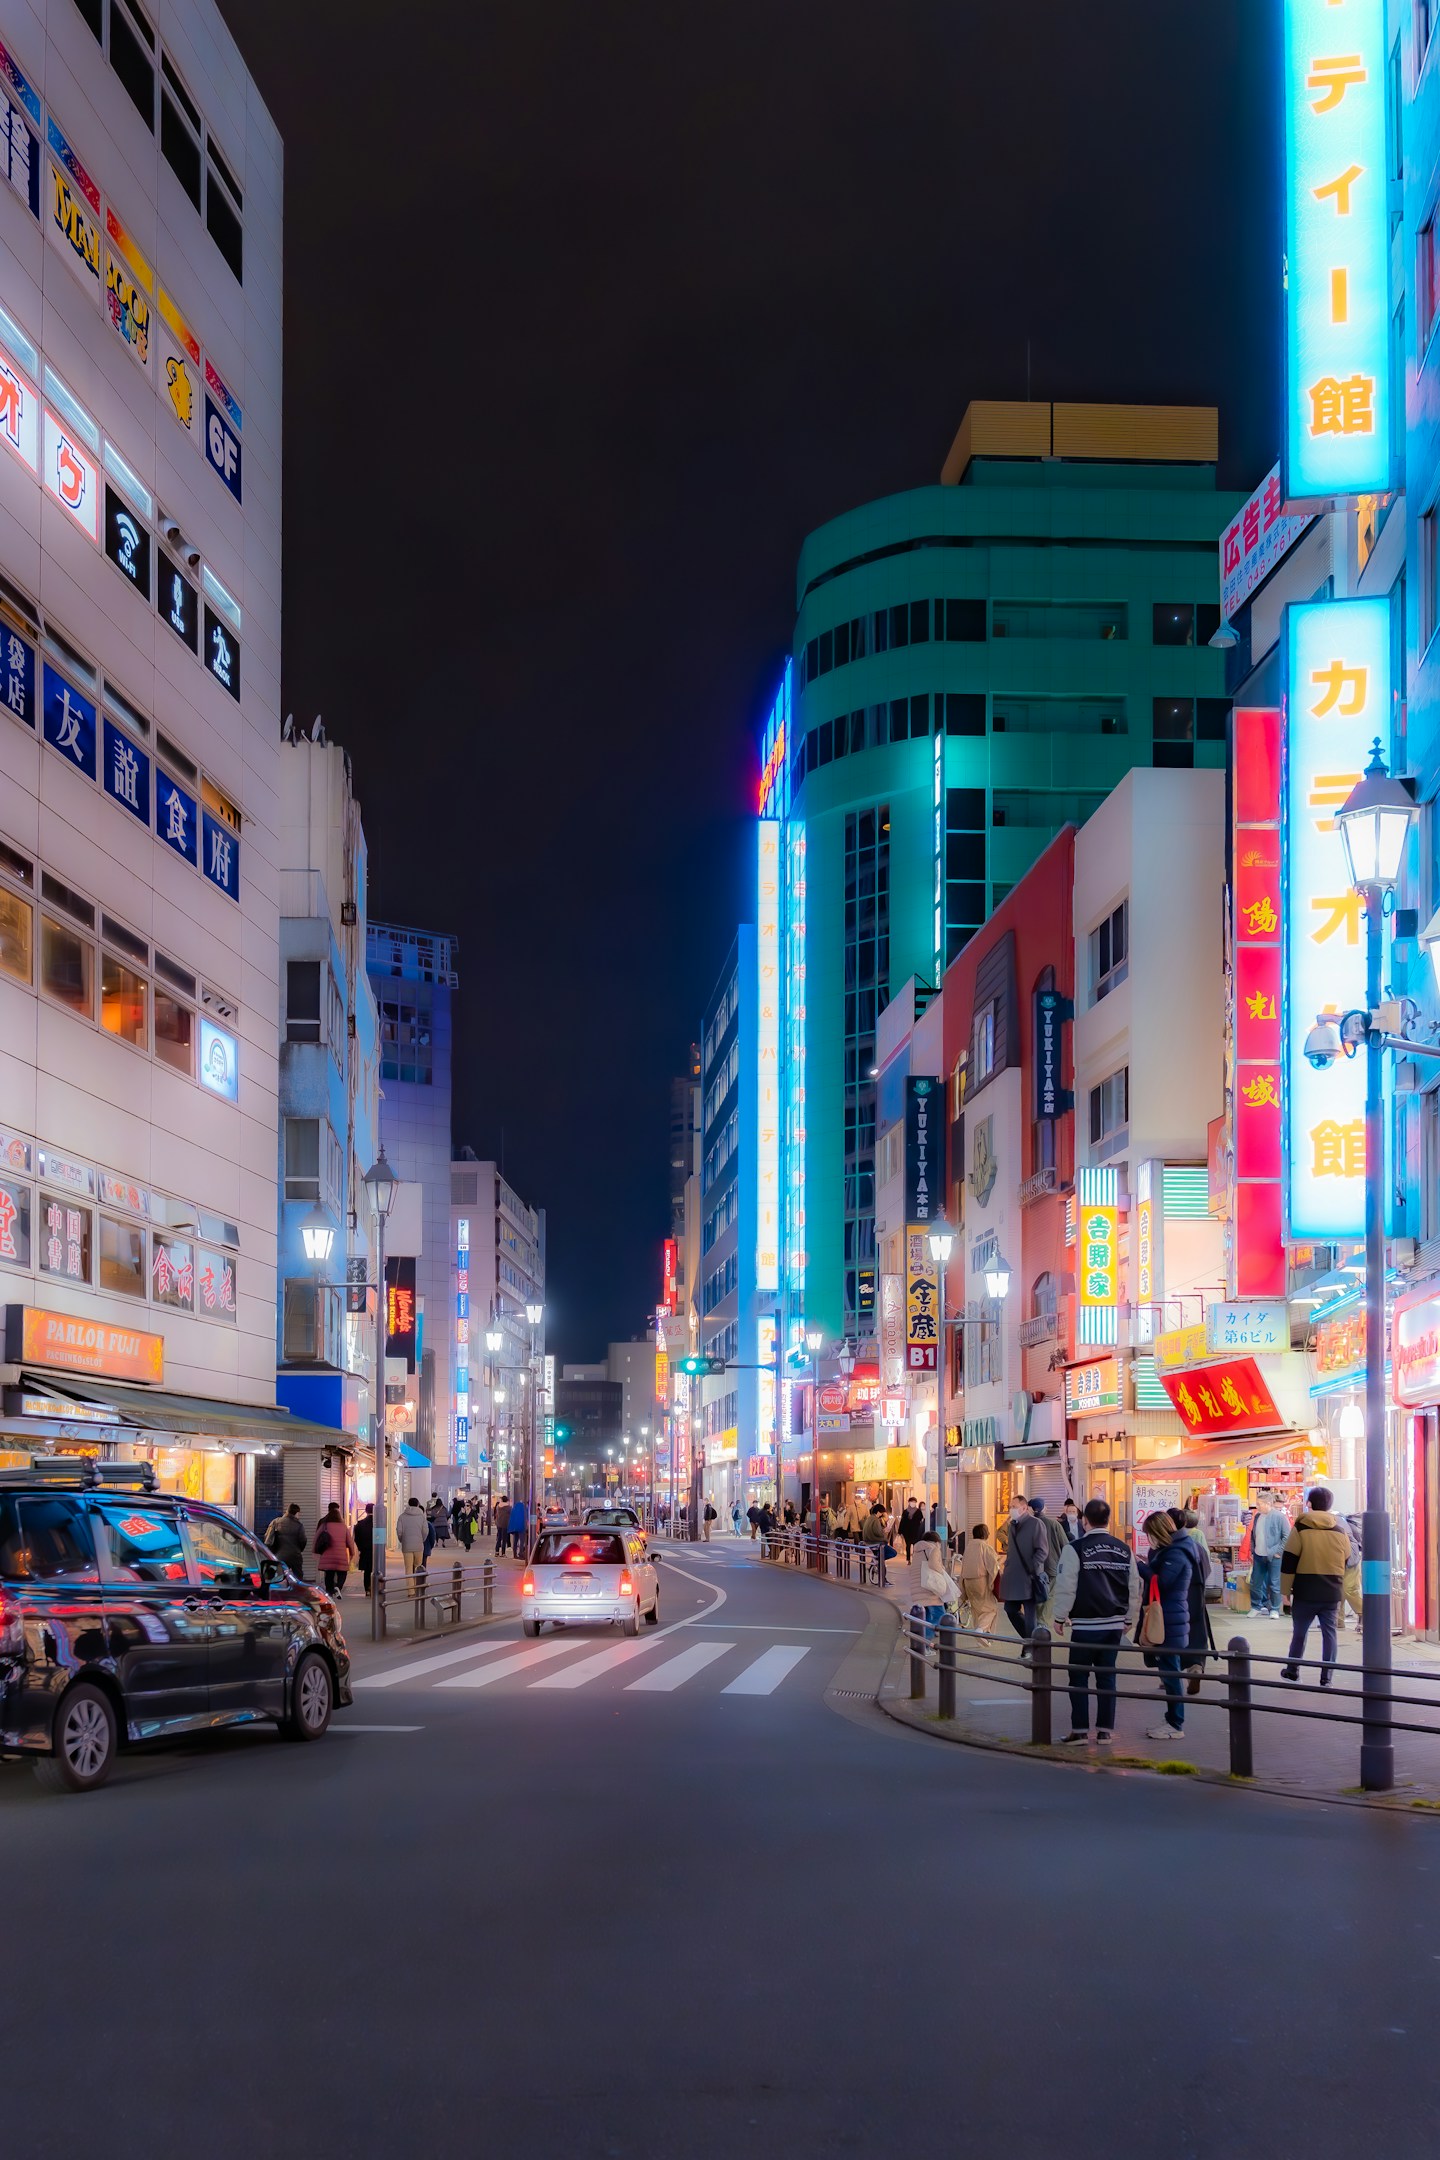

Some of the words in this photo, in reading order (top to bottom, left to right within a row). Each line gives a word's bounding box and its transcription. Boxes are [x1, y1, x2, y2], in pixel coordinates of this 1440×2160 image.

[1305, 0, 1375, 436] ティー館
[209, 413, 238, 476] 6F
[171, 609, 185, 633] USB
[1087, 1214, 1111, 1298] 吉野家
[858, 1283, 874, 1294] Bee
[395, 1289, 414, 1333] Wendy's
[909, 1279, 938, 1341] 金の蔵
[1226, 1312, 1269, 1324] カイダ
[47, 1319, 104, 1349] PARLOR
[109, 1332, 140, 1357] FUJI
[1225, 1329, 1277, 1344] 第6ビル
[910, 1347, 935, 1367] B1
[1136, 1486, 1179, 1498] 朝食べたら
[1138, 1499, 1176, 1508] 昼か夜が
